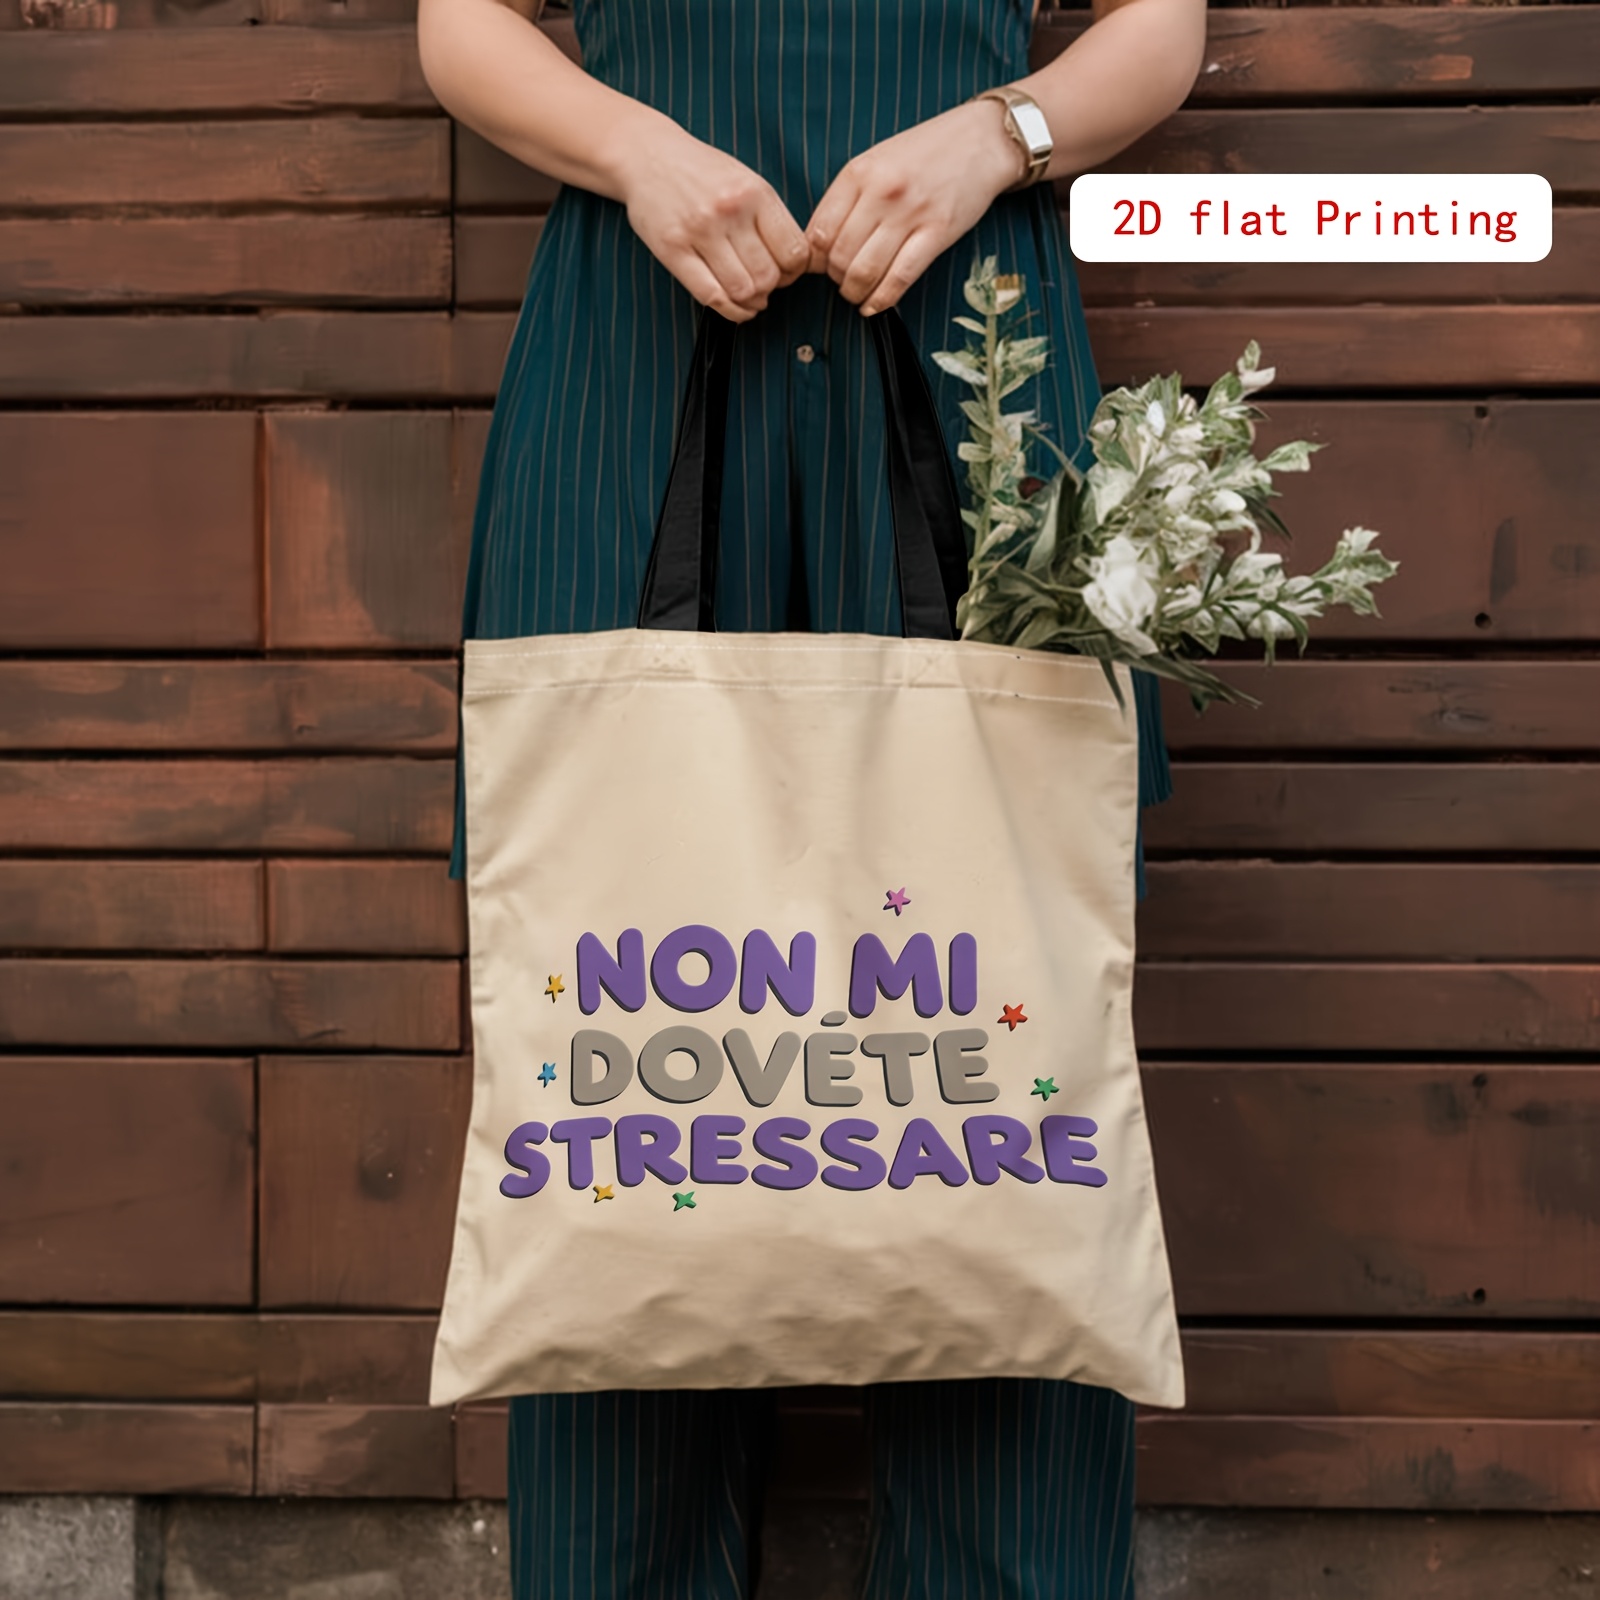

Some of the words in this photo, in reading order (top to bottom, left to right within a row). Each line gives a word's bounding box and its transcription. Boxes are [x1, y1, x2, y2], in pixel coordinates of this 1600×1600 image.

[576, 924, 817, 1016] NON
[848, 932, 978, 1018] MI
[570, 1011, 1001, 1108] DOVÉTE
[499, 1114, 1108, 1199] STRESSARE
